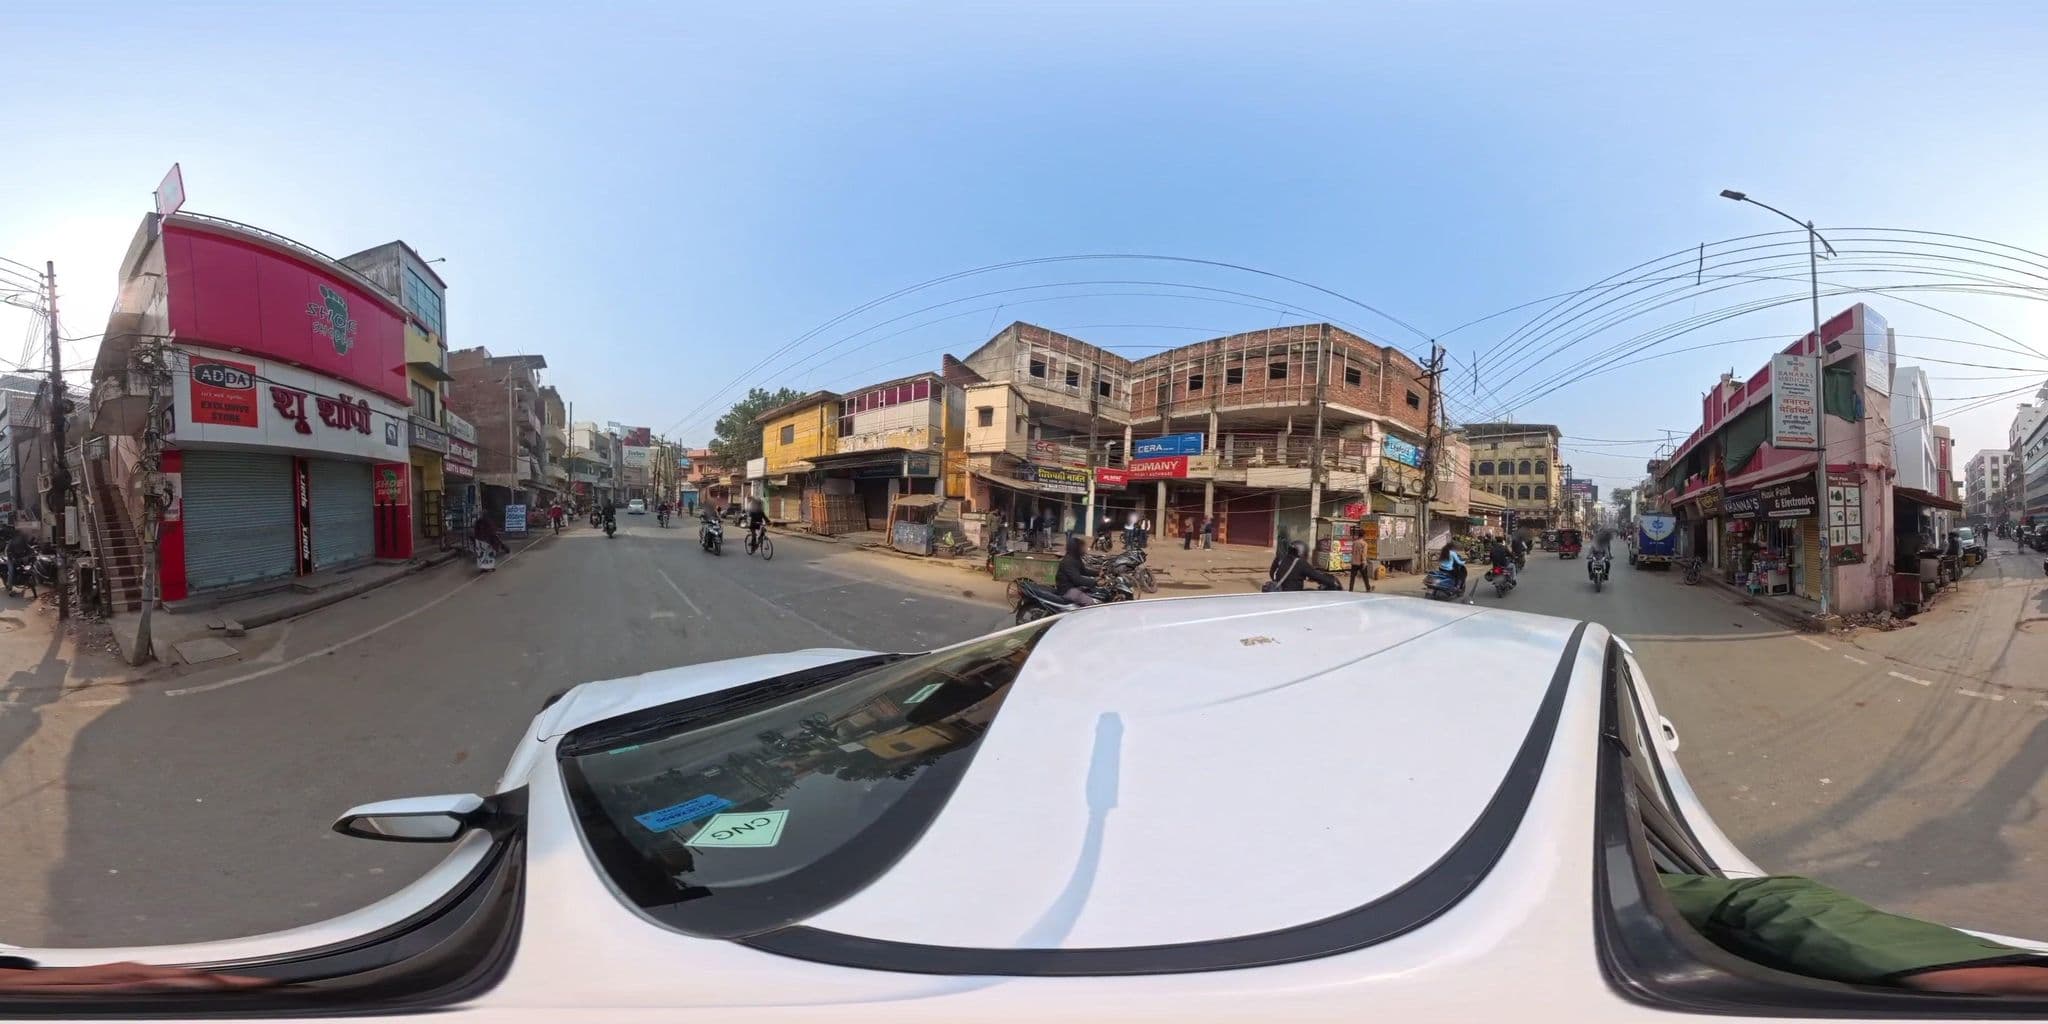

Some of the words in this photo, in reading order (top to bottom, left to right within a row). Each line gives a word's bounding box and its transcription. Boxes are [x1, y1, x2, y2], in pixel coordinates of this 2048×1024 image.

[201, 367, 247, 386] ADDA
[201, 401, 249, 413] EXCLUSIVE
[269, 386, 312, 435] शू
[315, 393, 373, 435] शॉपी
[212, 412, 241, 422] STORE
[1138, 444, 1162, 453] CERA
[1131, 461, 1179, 471] SOMANY
[1782, 496, 1816, 508] Electronics
[711, 817, 771, 840] CNG
